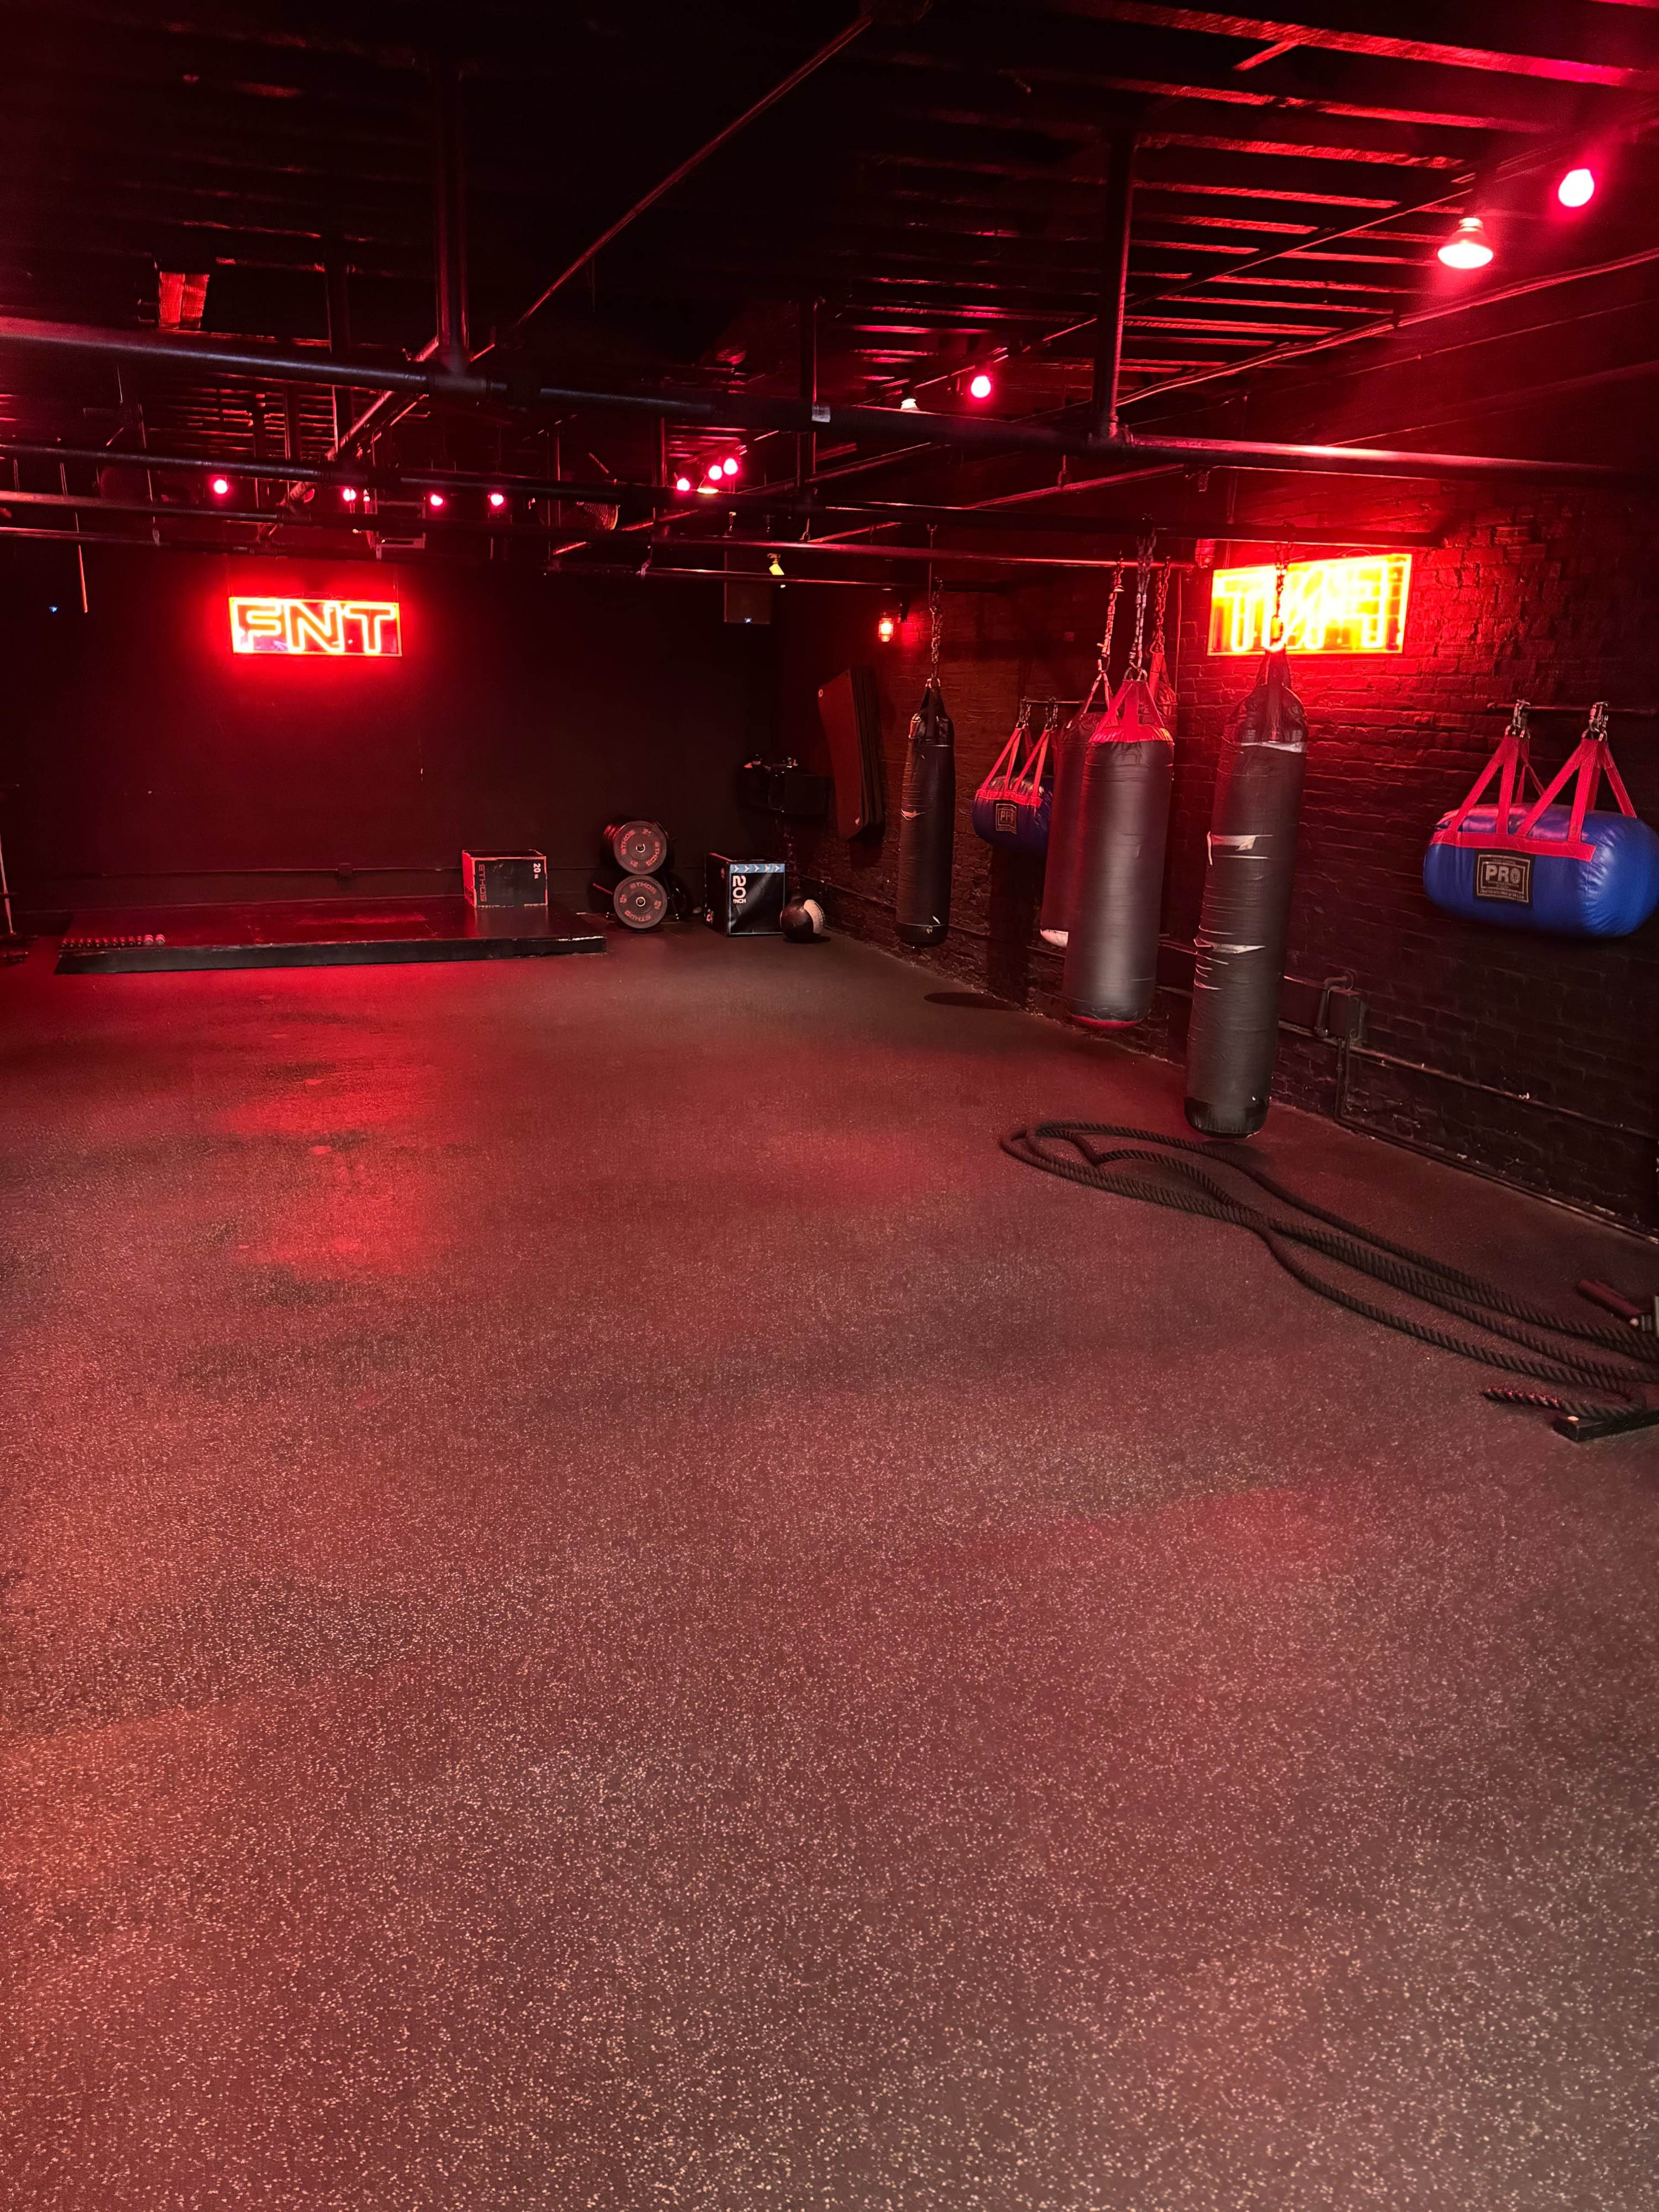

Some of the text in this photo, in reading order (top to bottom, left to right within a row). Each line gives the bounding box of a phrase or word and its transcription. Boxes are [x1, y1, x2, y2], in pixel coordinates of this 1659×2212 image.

[232, 600, 397, 653] FNT
[533, 863, 541, 873] 20
[1485, 865, 1521, 884] PRO
[732, 875, 747, 899] 20
